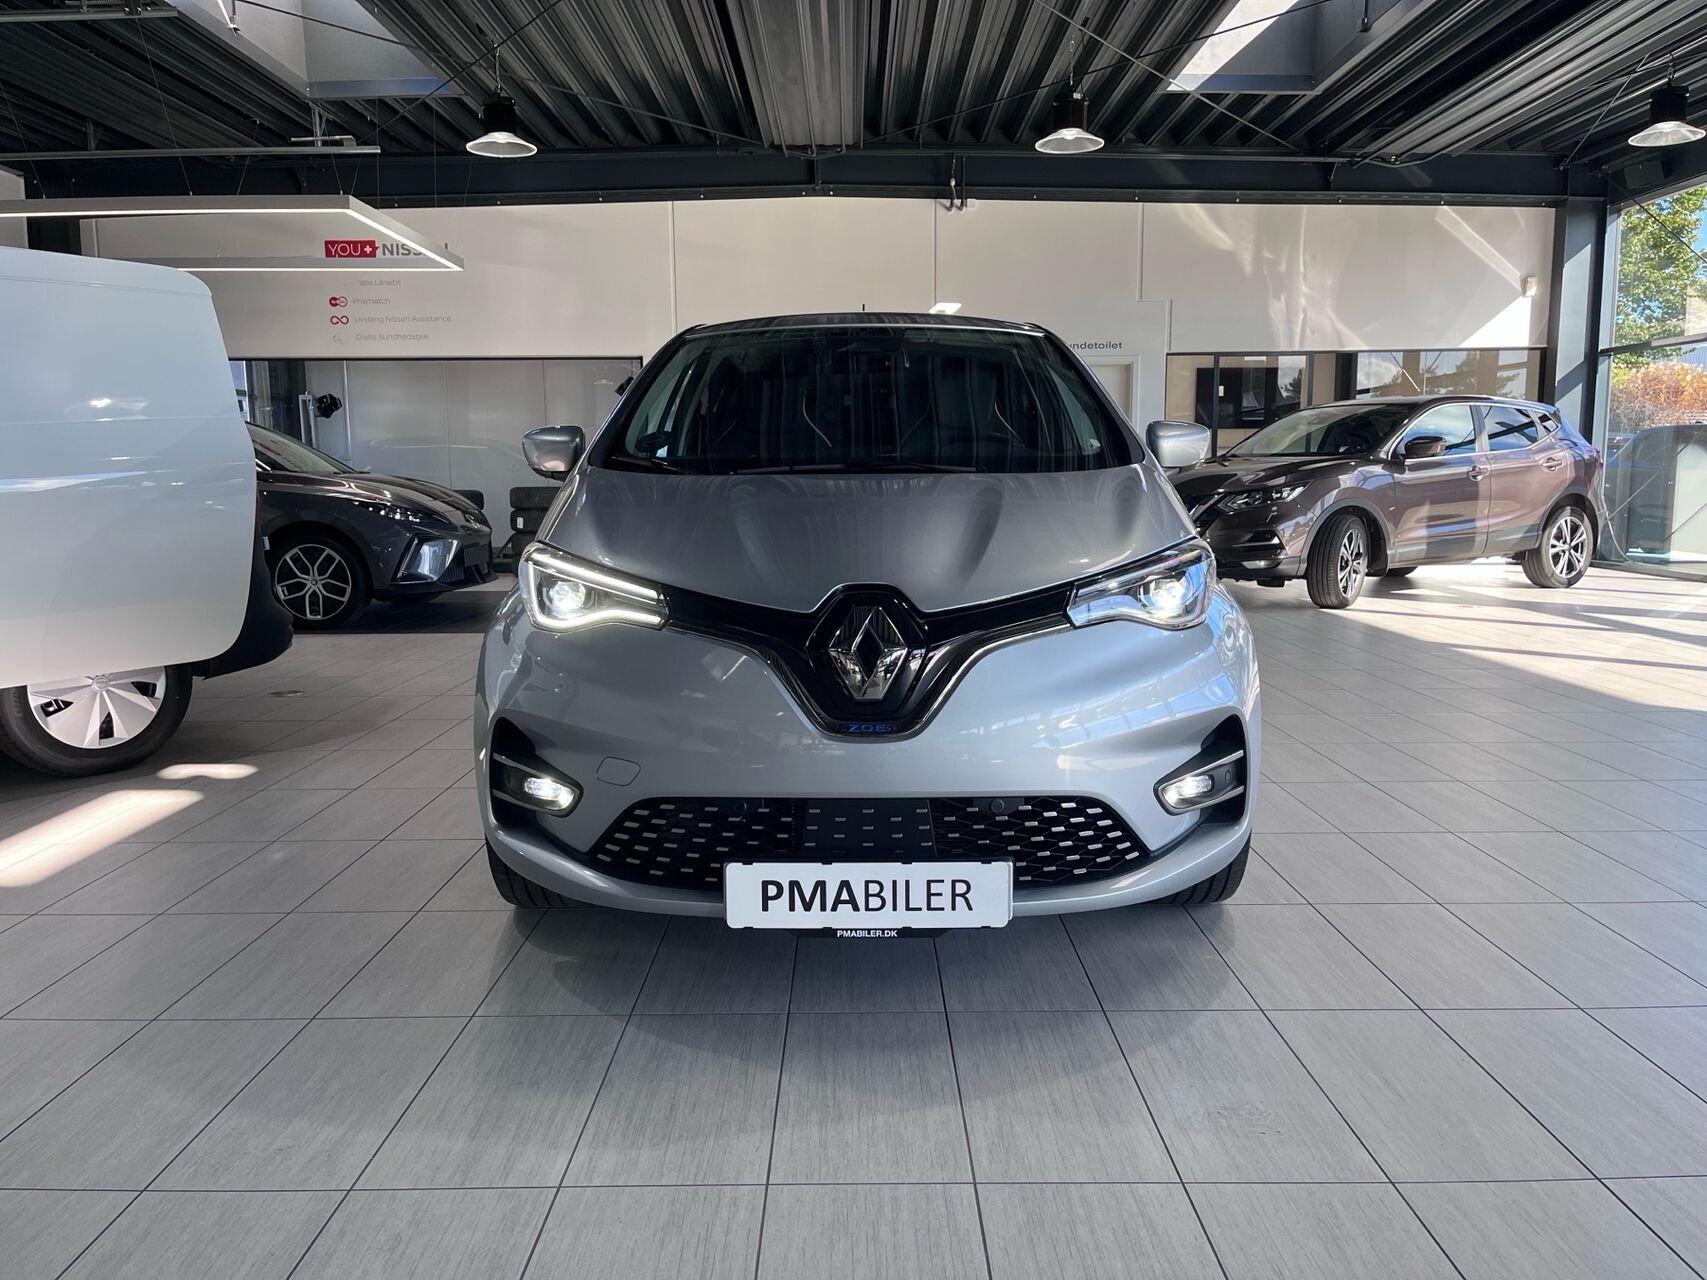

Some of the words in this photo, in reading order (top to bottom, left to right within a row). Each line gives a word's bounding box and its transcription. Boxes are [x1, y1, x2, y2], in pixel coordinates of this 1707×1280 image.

[352, 297, 391, 305] Prismatch
[412, 314, 451, 322] Assistance
[1069, 341, 1122, 350] ndetoilet
[848, 723, 888, 732] ZOE
[760, 879, 974, 913] PMABILER
[836, 929, 898, 938] PMABILER.DK
